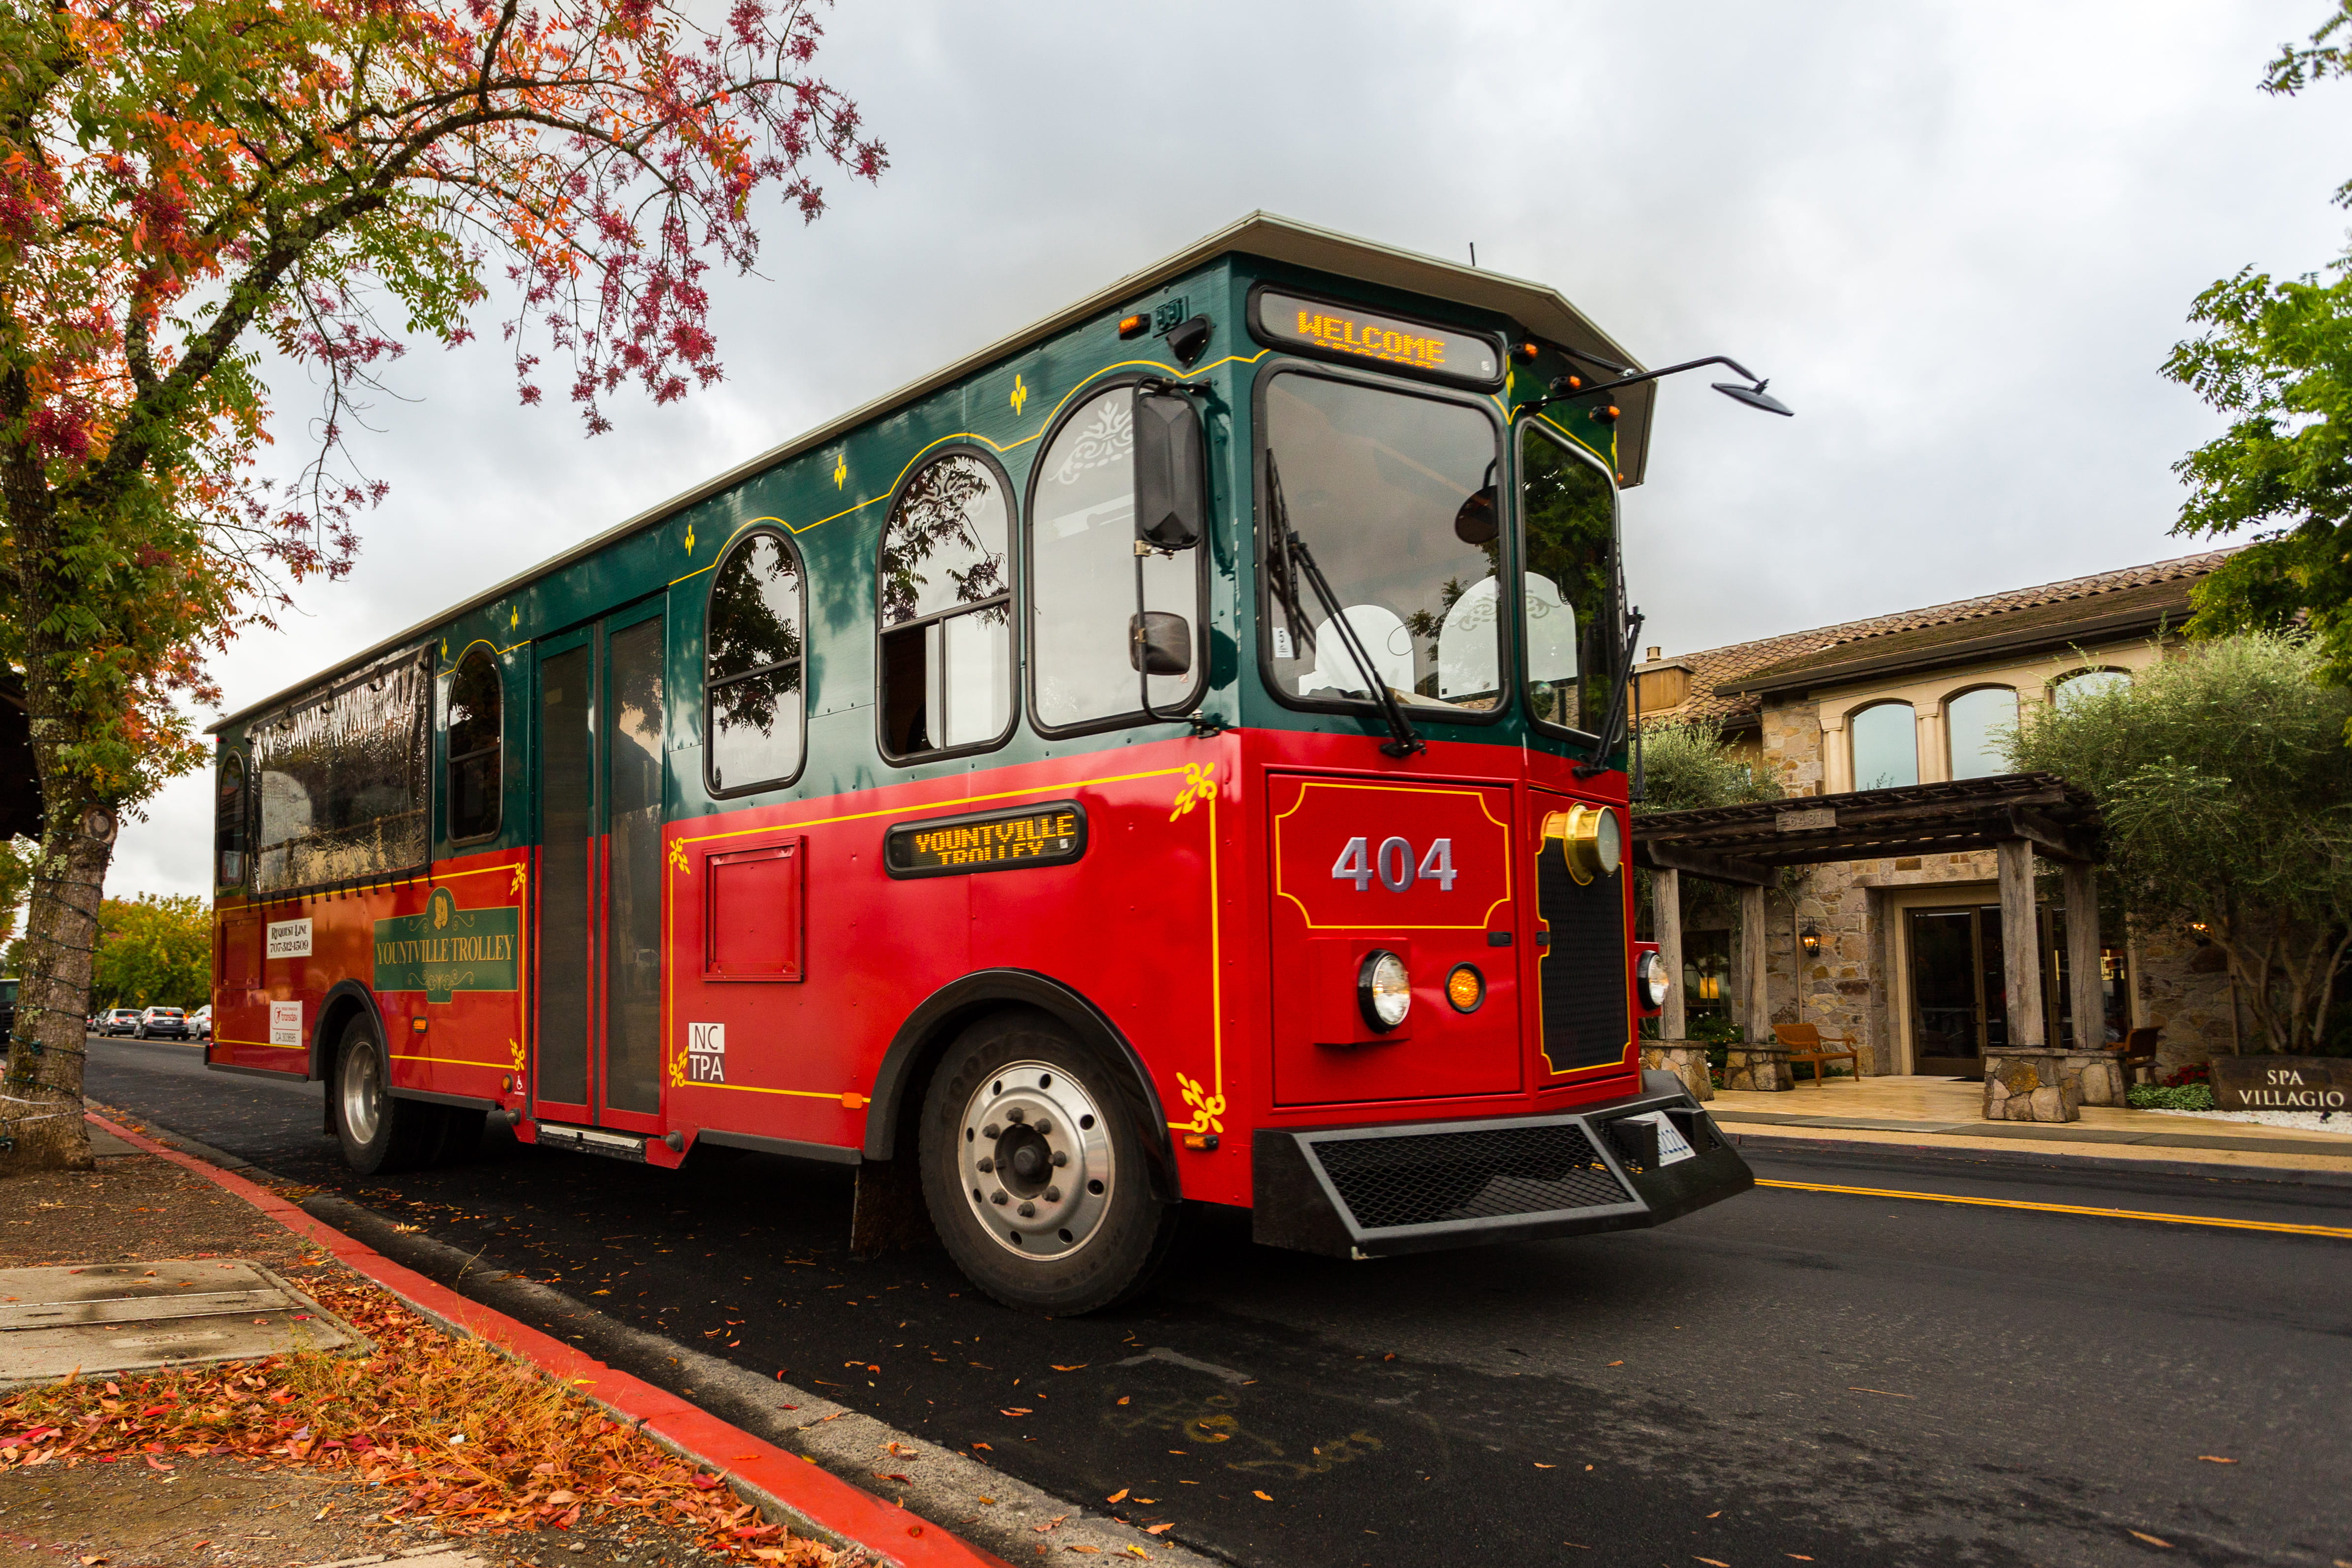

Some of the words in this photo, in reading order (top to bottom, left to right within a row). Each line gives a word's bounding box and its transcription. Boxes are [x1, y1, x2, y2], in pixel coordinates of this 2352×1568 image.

[1298, 311, 1445, 363] WELCOME
[1790, 812, 1824, 827] 6481
[916, 815, 1075, 853] YOUNTVILLE
[1331, 836, 1458, 893] 404
[270, 940, 309, 953] 707-312-1509
[376, 939, 449, 965] YOUNTVILLE
[451, 935, 515, 961] TROLLEY
[695, 1025, 718, 1050] NC
[689, 1055, 724, 1081] TPA
[2267, 1070, 2305, 1085] SPA
[2238, 1090, 2344, 1107] VILLAGIO
